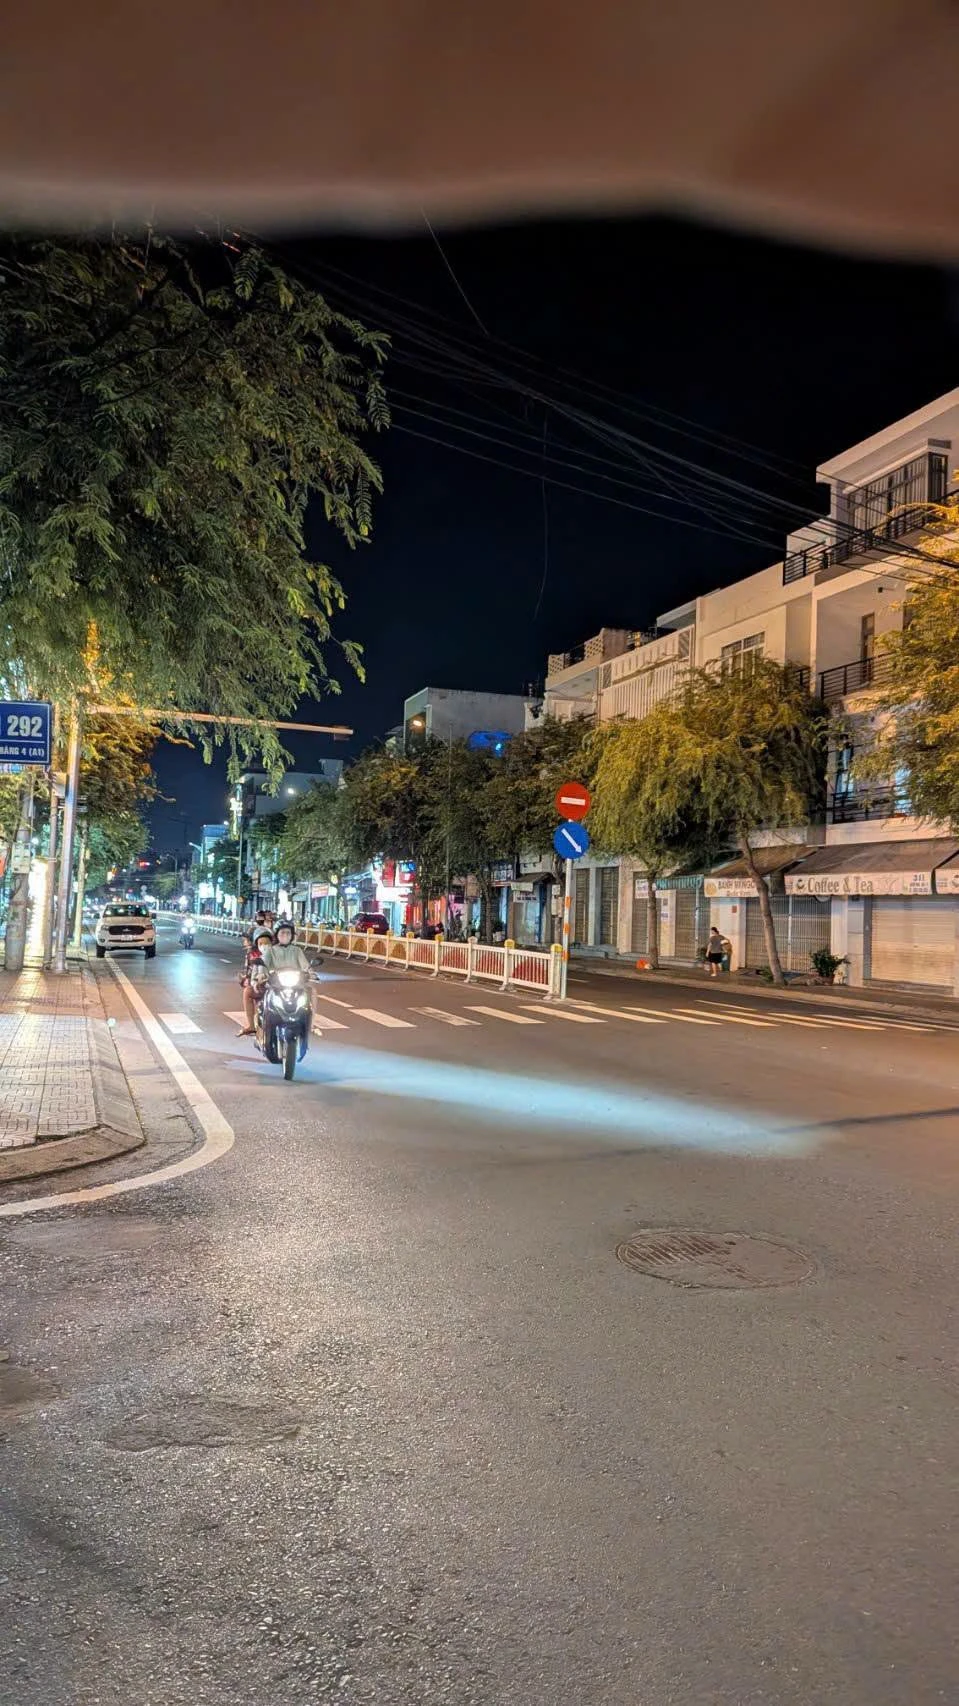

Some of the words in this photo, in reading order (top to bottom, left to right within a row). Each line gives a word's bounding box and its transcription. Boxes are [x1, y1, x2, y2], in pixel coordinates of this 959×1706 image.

[7, 714, 43, 738] 292
[21, 747, 27, 756] 4
[28, 747, 45, 757] (A1)
[807, 876, 840, 893] Coffee
[842, 876, 851, 893] &
[853, 875, 874, 893] Tea
